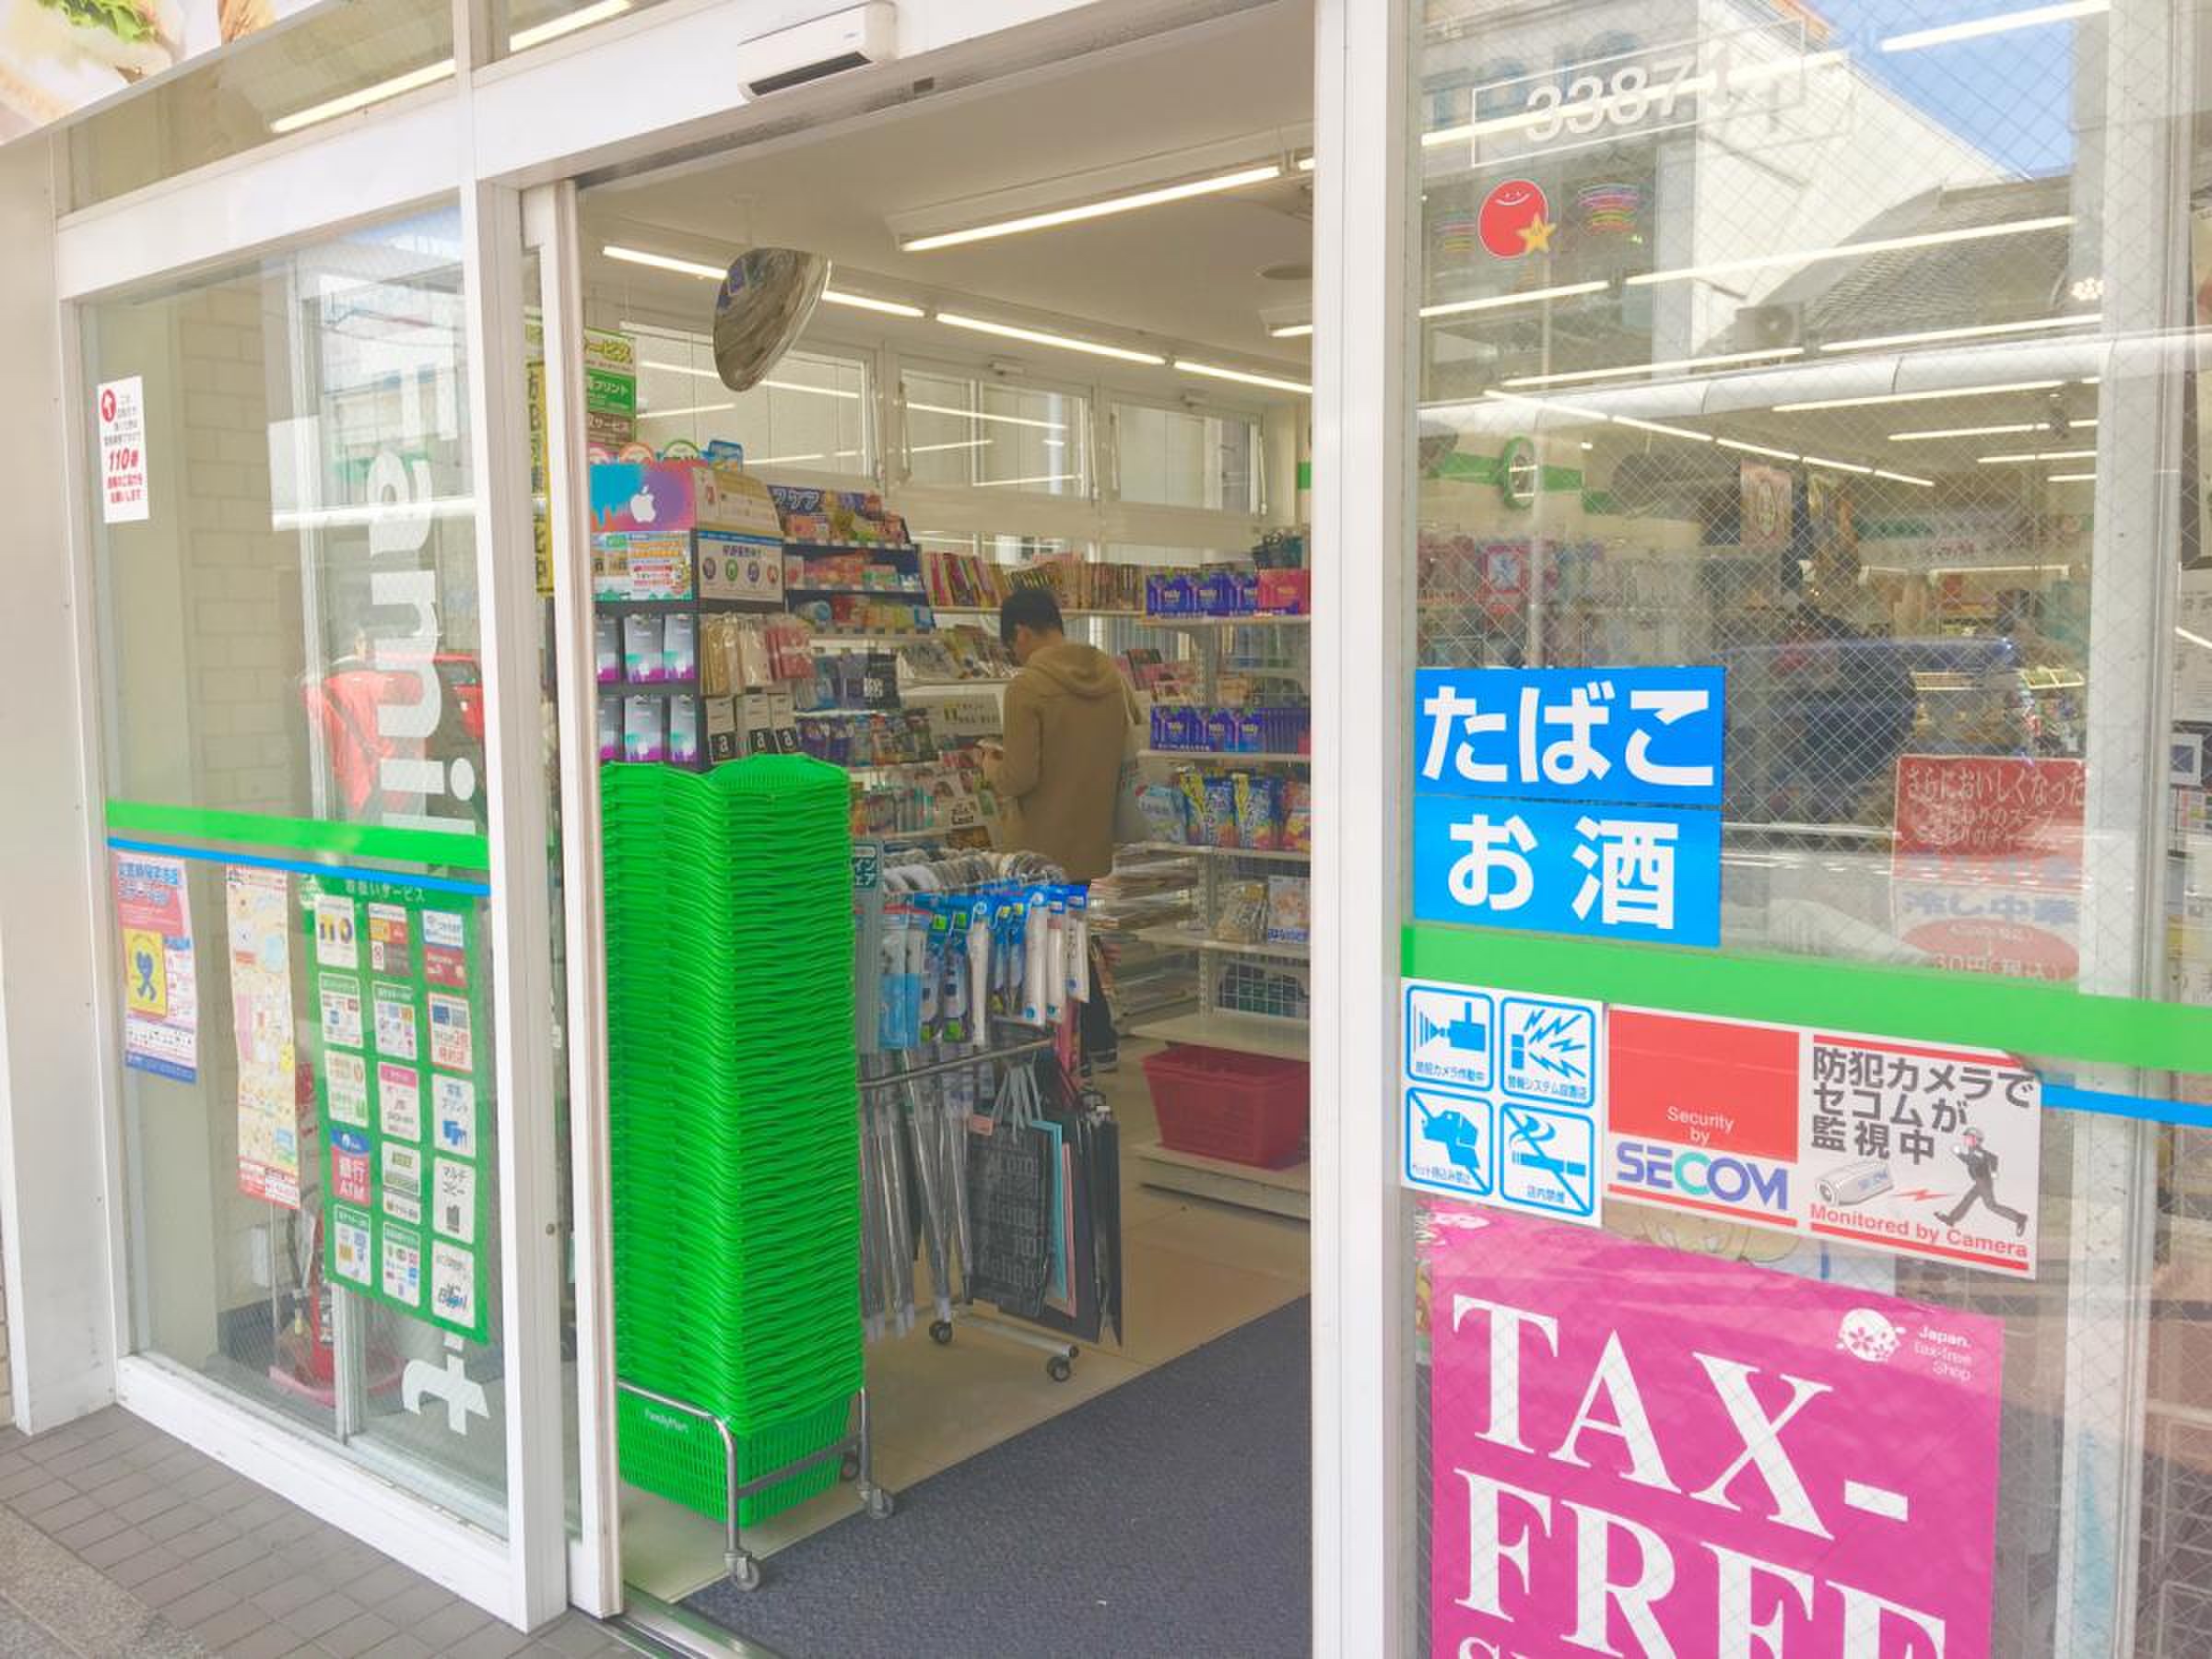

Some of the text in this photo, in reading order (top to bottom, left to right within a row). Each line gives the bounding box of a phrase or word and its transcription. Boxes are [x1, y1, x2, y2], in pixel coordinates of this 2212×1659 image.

[1422, 680, 1714, 786] たばこ
[1448, 814, 1679, 930] お酒
[1813, 1045, 2035, 1109] 防犯カメラで
[1666, 1105, 1735, 1133] Security
[1689, 1125, 1710, 1147] by
[1813, 1082, 1969, 1133] セコムが
[1811, 1115, 1935, 1166] 監視中
[1617, 1141, 1788, 1210] SECOM
[1810, 1203, 2028, 1258] Monitored by Camera
[1453, 1293, 1909, 1541] TAX-
